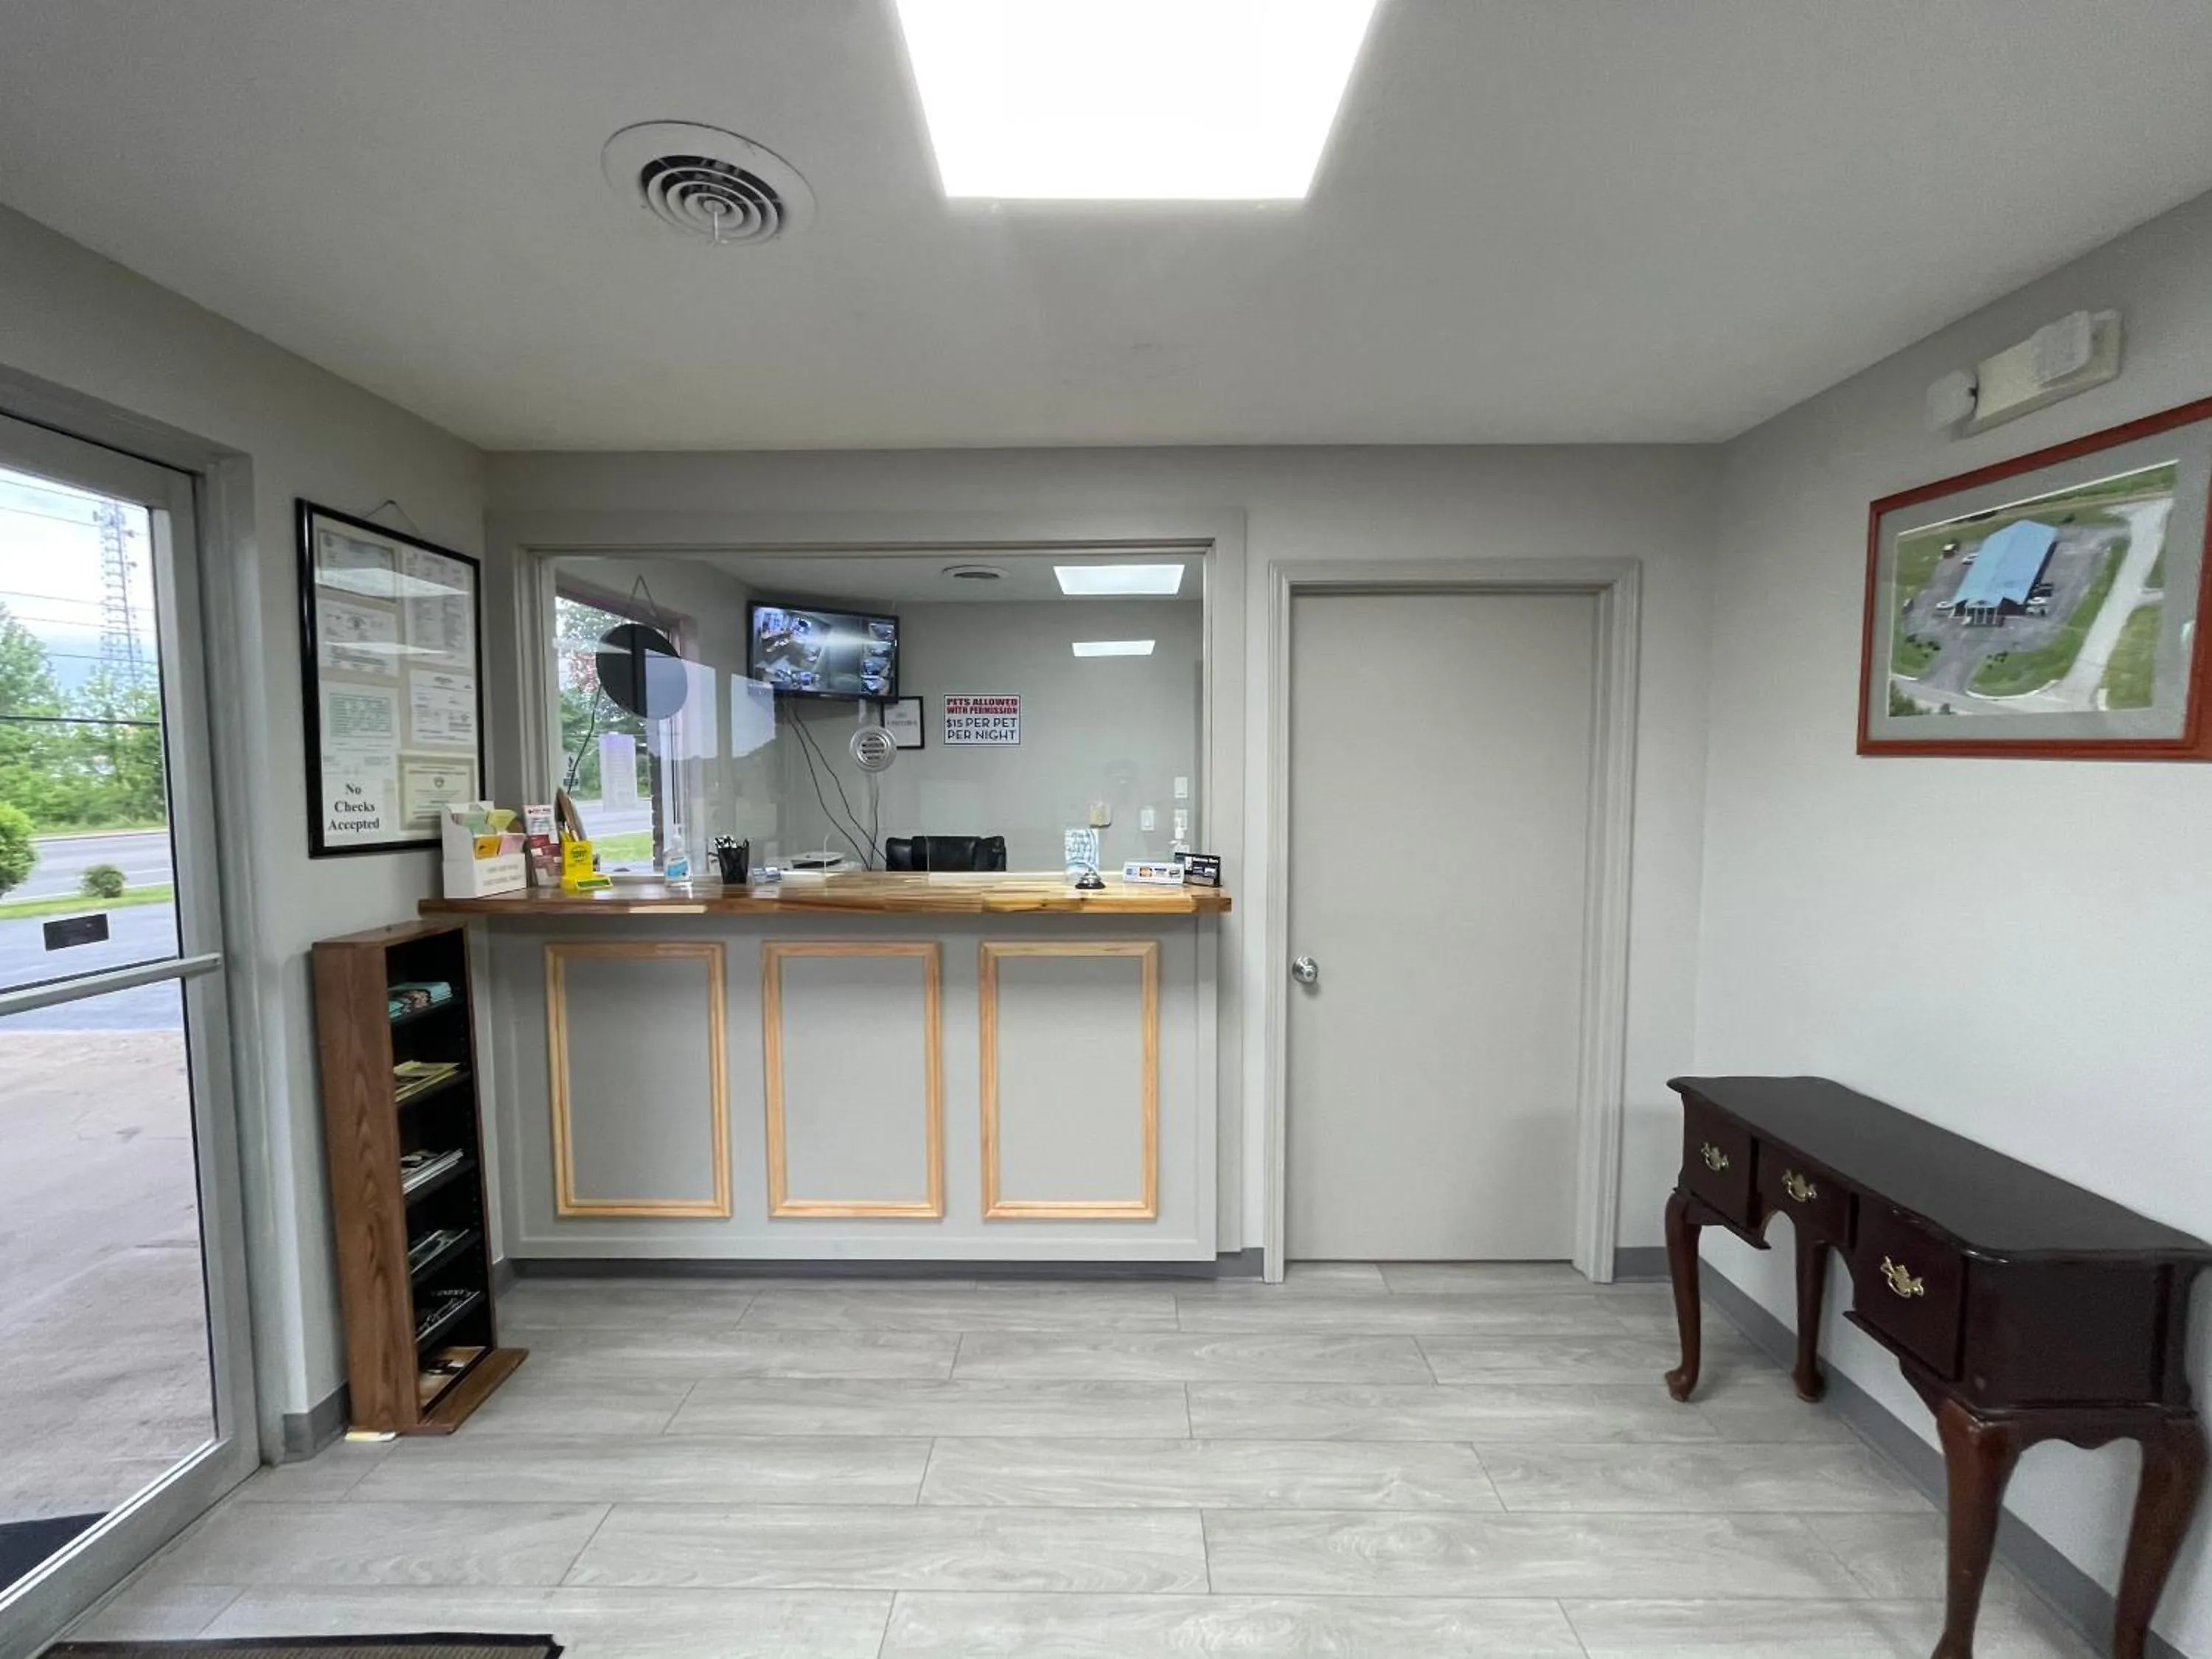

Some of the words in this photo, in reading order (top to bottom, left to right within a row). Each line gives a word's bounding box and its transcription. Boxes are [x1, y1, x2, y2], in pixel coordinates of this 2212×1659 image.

[946, 706, 967, 714] WITH
[970, 706, 1018, 714] PERMISSION
[946, 718, 963, 728] $15
[965, 717, 990, 728] PER
[993, 717, 1018, 728] PET
[947, 729, 971, 740] PER
[975, 729, 1015, 740] NIGHT
[346, 783, 362, 795] No
[334, 800, 375, 813] Checks
[328, 817, 380, 832] Accepted
